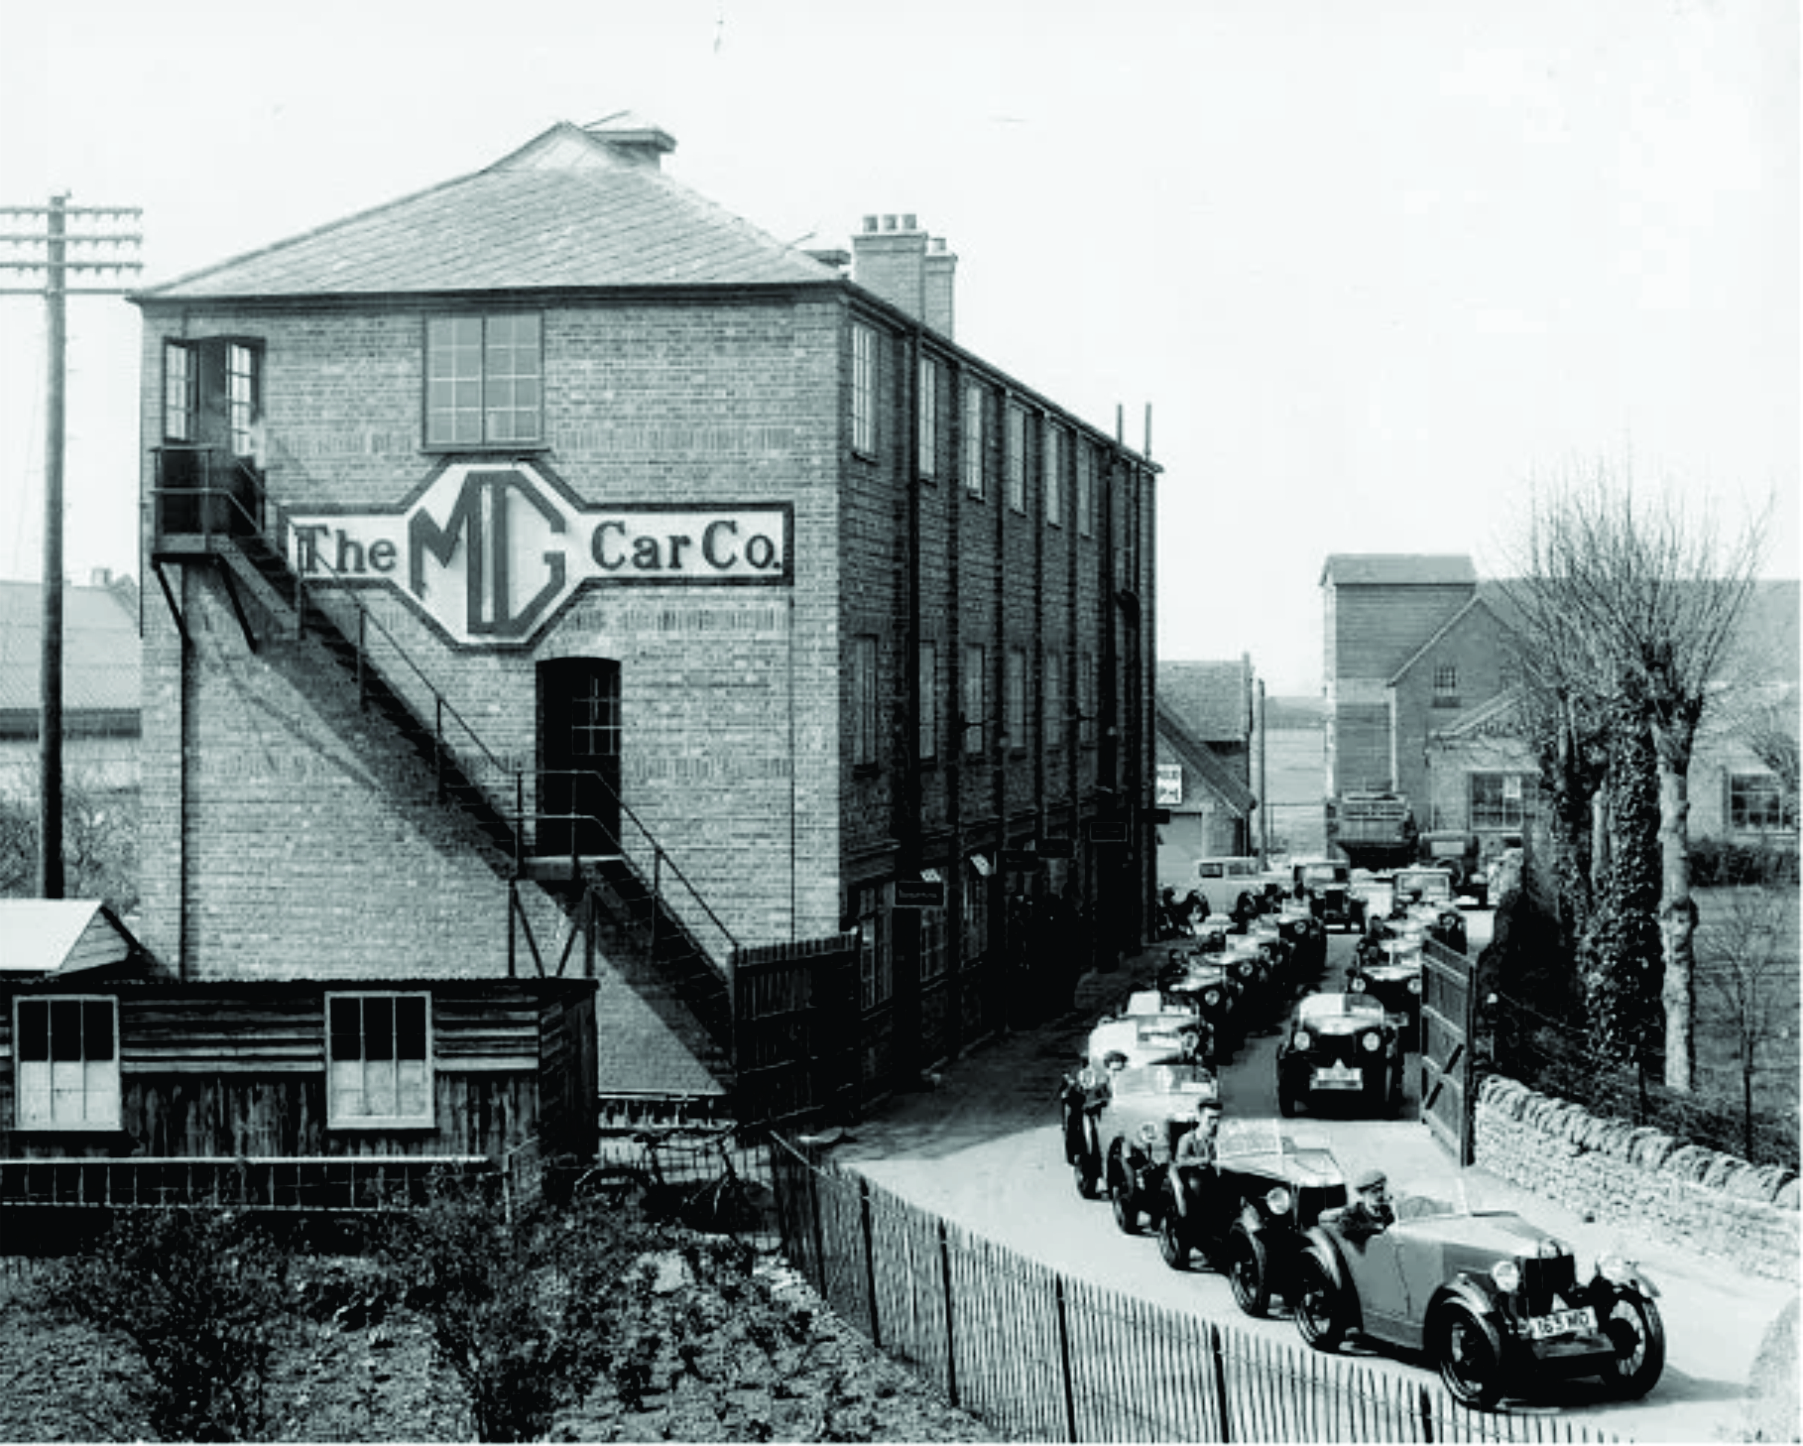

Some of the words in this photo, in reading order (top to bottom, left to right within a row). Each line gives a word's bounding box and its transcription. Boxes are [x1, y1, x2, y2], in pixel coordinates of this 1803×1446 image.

[294, 523, 397, 574] The
[408, 470, 567, 637] MG
[591, 520, 692, 570] Car
[701, 520, 782, 570] Co.
